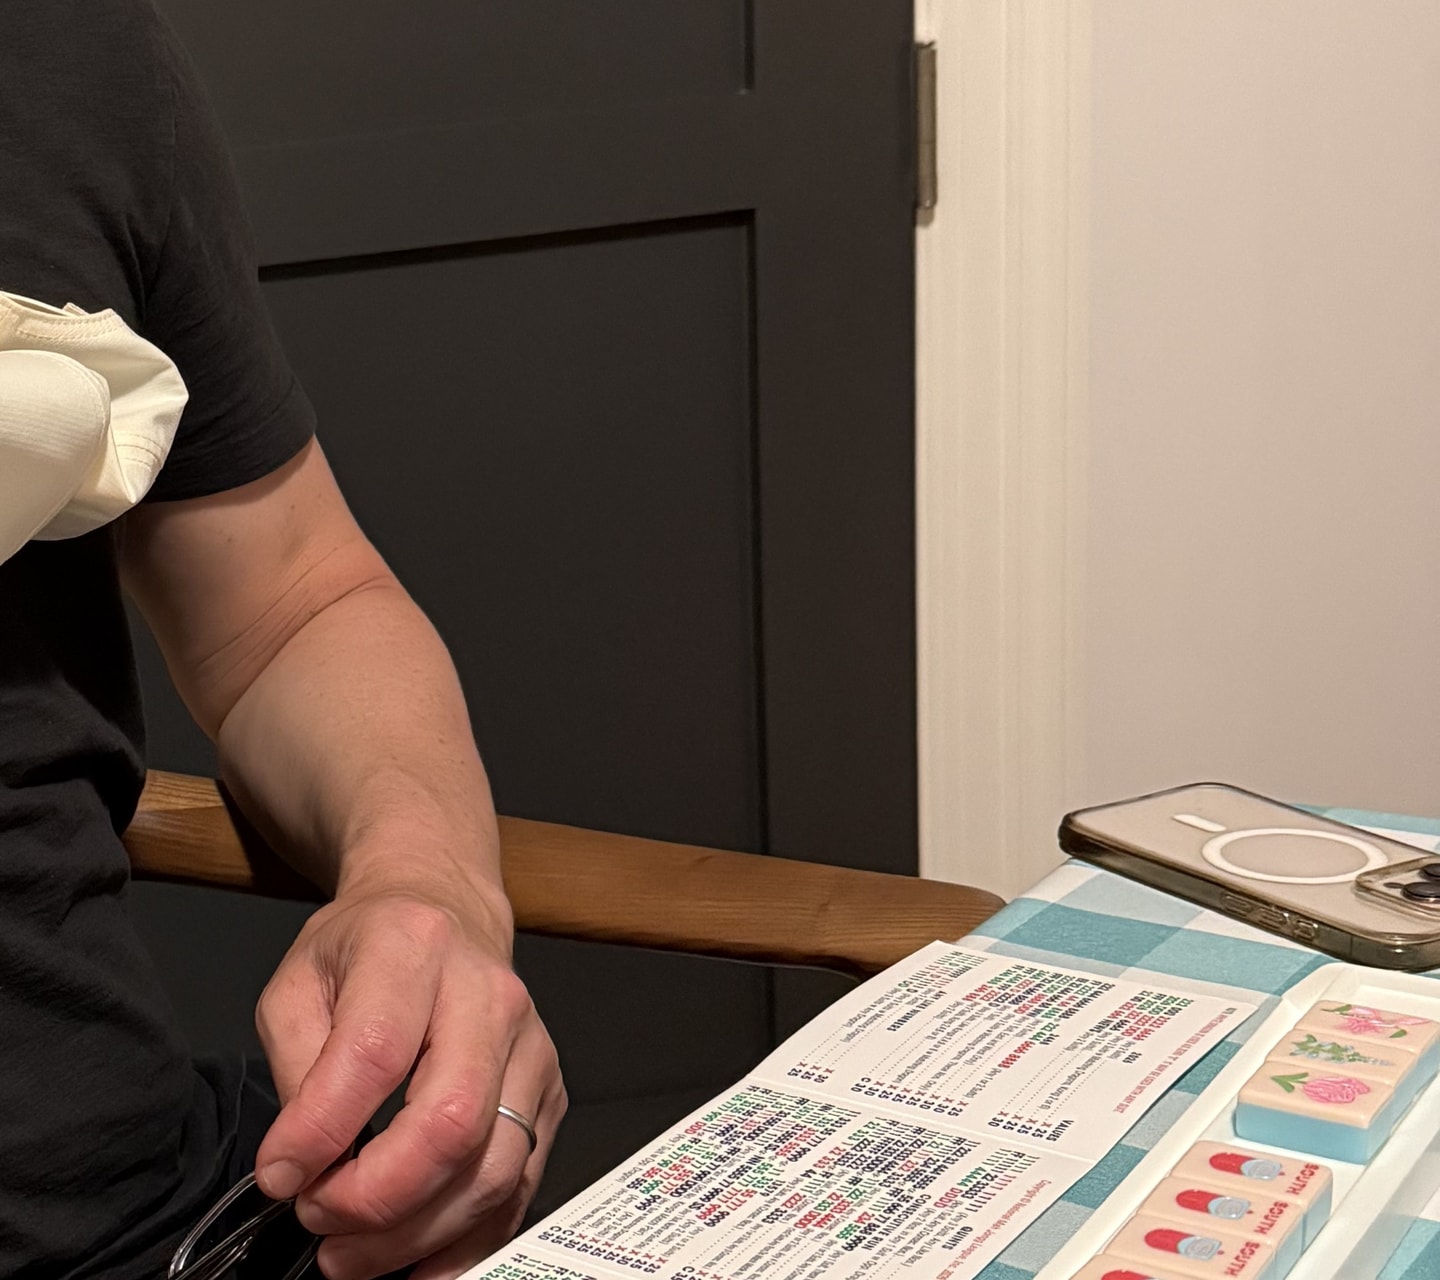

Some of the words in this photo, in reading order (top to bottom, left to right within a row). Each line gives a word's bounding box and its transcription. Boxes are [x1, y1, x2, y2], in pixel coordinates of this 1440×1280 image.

[986, 1117, 1005, 1127] 30
[1001, 1121, 1019, 1130] 25
[1015, 1125, 1033, 1134] 25
[1044, 1119, 1075, 1141] VALUES
[1030, 1128, 1048, 1138] 25
[1287, 1163, 1319, 1196] SOUTH
[877, 1194, 932, 1236] CONSECUTIVE
[1255, 1201, 1288, 1235] SOUTH
[860, 1236, 883, 1250] RUN
[941, 1226, 974, 1250] QUINTS
[509, 1253, 529, 1263] FF
[1224, 1241, 1260, 1277] SOUTH
